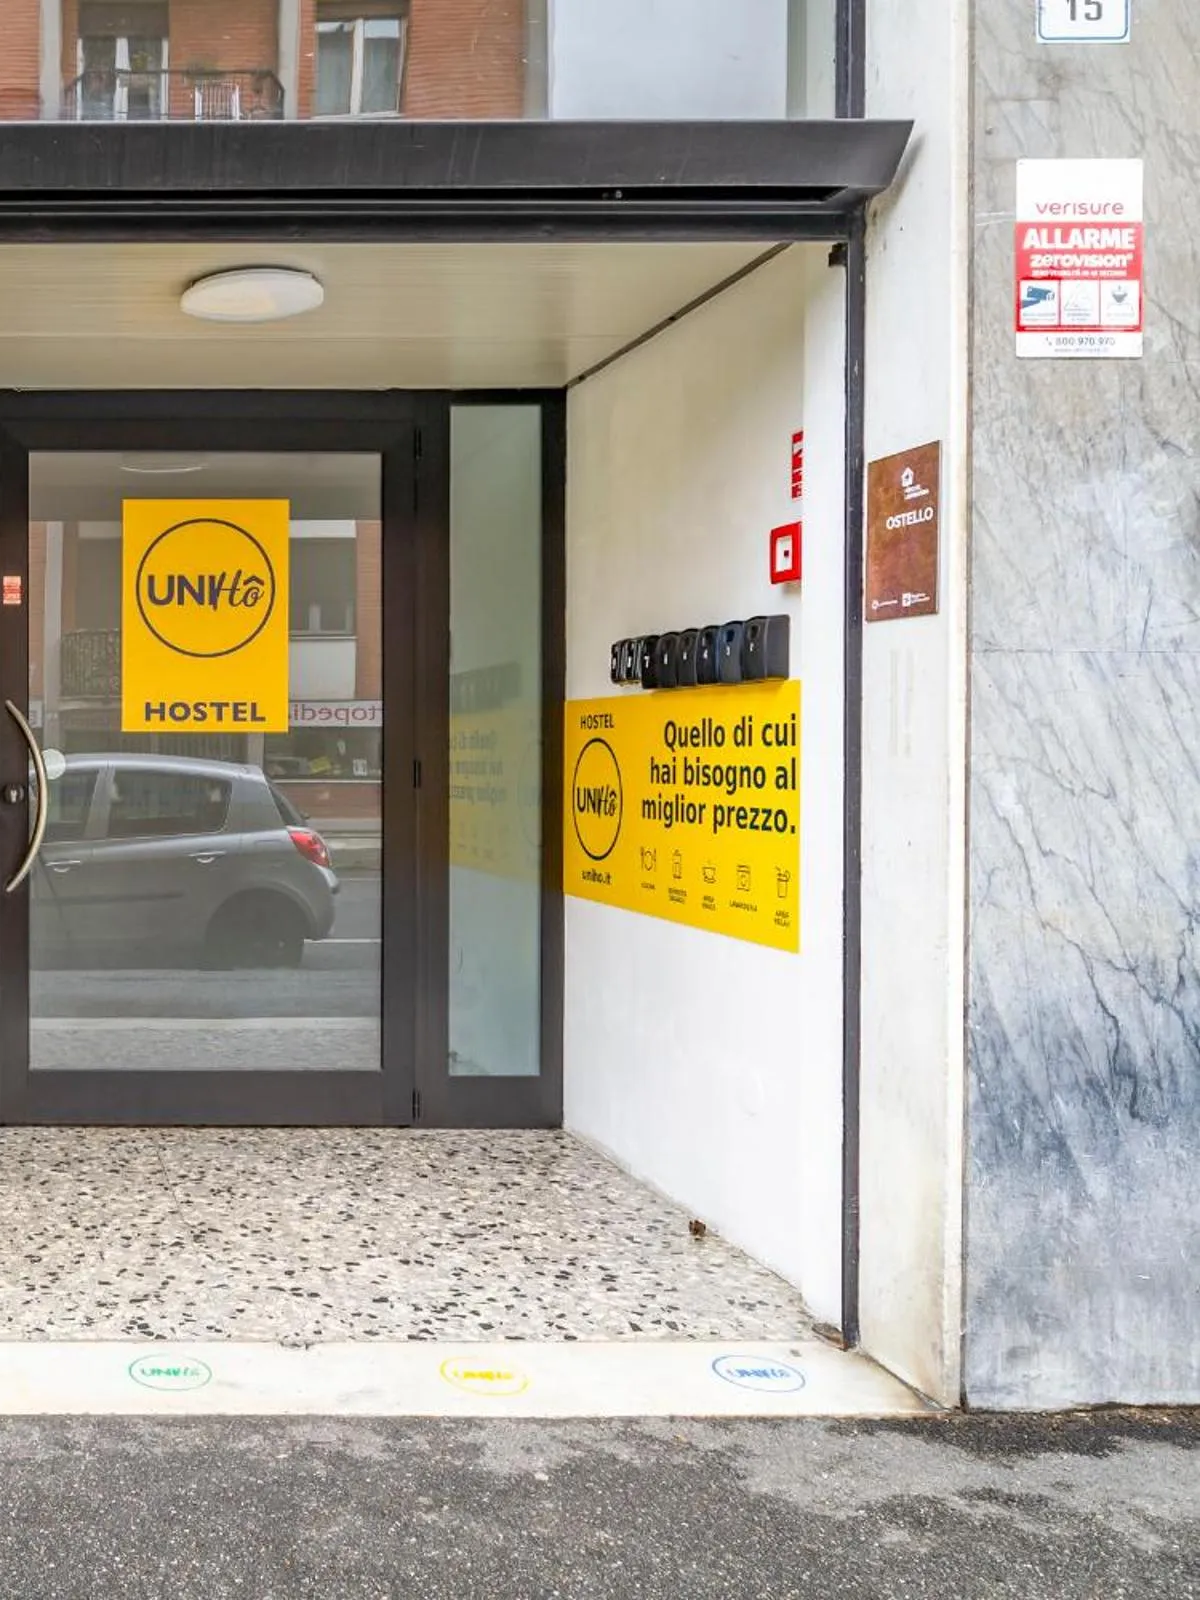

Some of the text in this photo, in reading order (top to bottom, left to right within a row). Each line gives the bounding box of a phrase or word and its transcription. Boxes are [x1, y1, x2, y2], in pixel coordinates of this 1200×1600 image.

[1066, 0, 1103, 21] 15
[1035, 202, 1125, 215] verisure
[1023, 228, 1136, 250] ALLARME
[885, 506, 934, 530] OSTELLO
[144, 701, 266, 722] HOSTEL
[580, 714, 615, 729] HOSTEL
[663, 713, 797, 752] Quello di cui
[650, 756, 797, 796] hai bisogno al
[642, 794, 796, 834] miglior prezzo.
